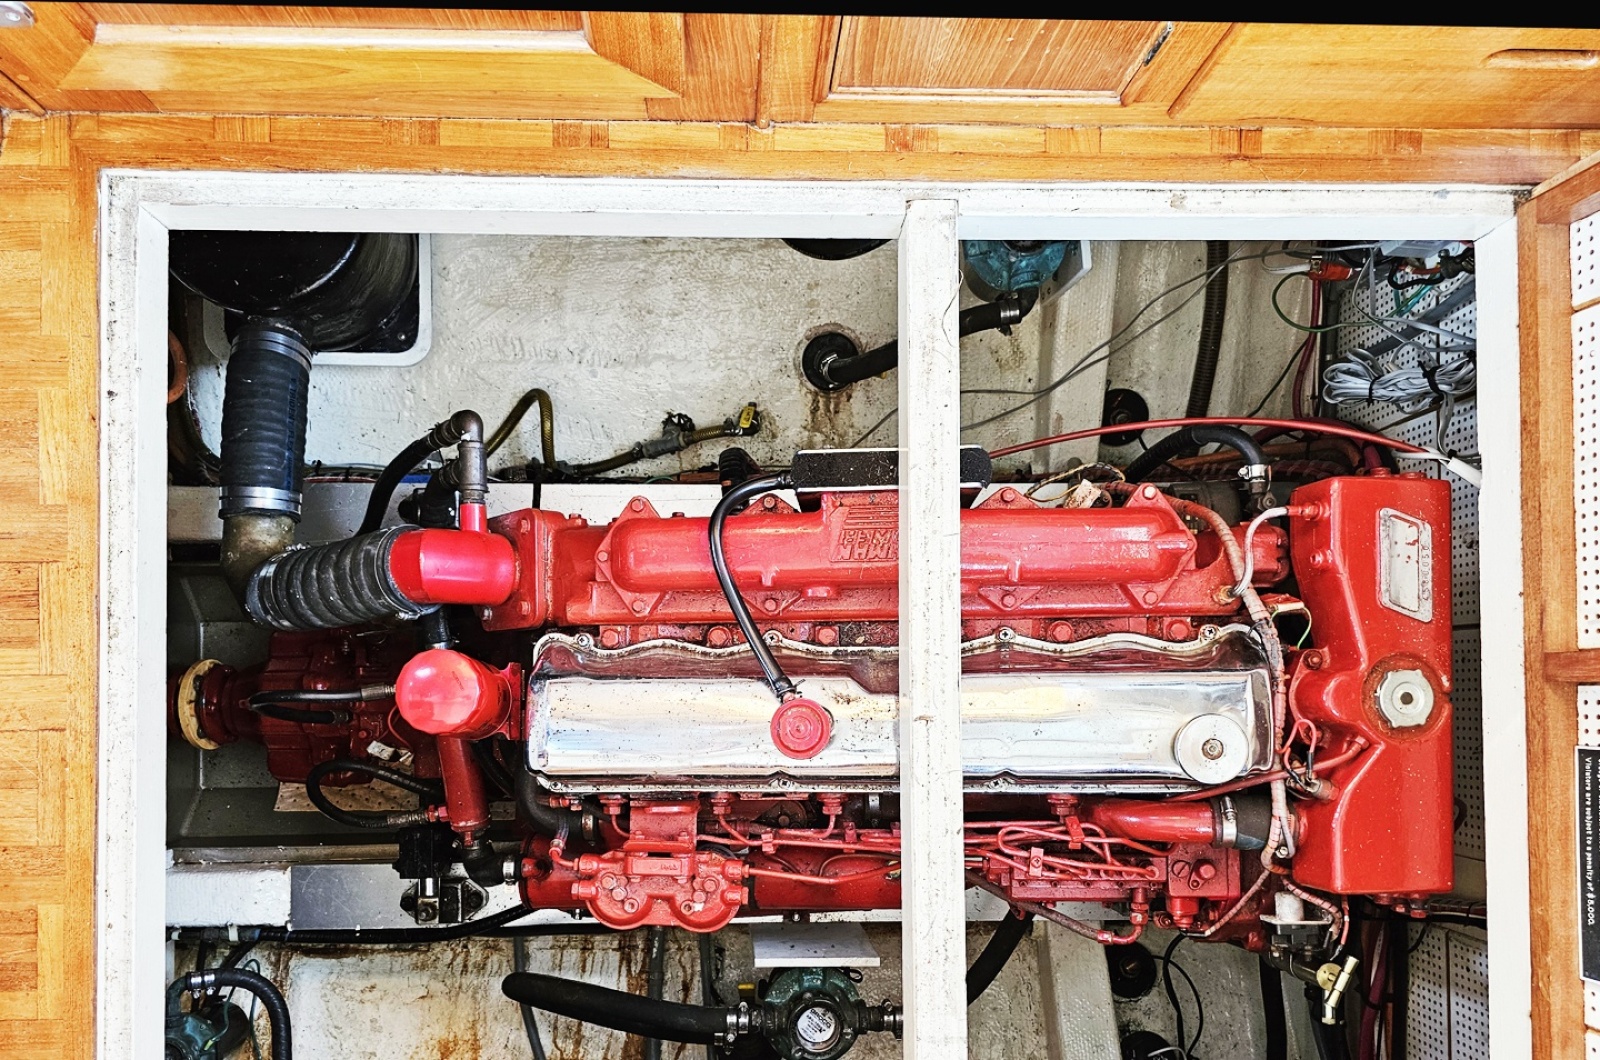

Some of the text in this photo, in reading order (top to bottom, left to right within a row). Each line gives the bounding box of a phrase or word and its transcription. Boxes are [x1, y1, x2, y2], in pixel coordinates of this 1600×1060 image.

[288, 388, 297, 425] TRIDENT
[1585, 852, 1593, 880] penalty
[1586, 882, 1594, 891] of
